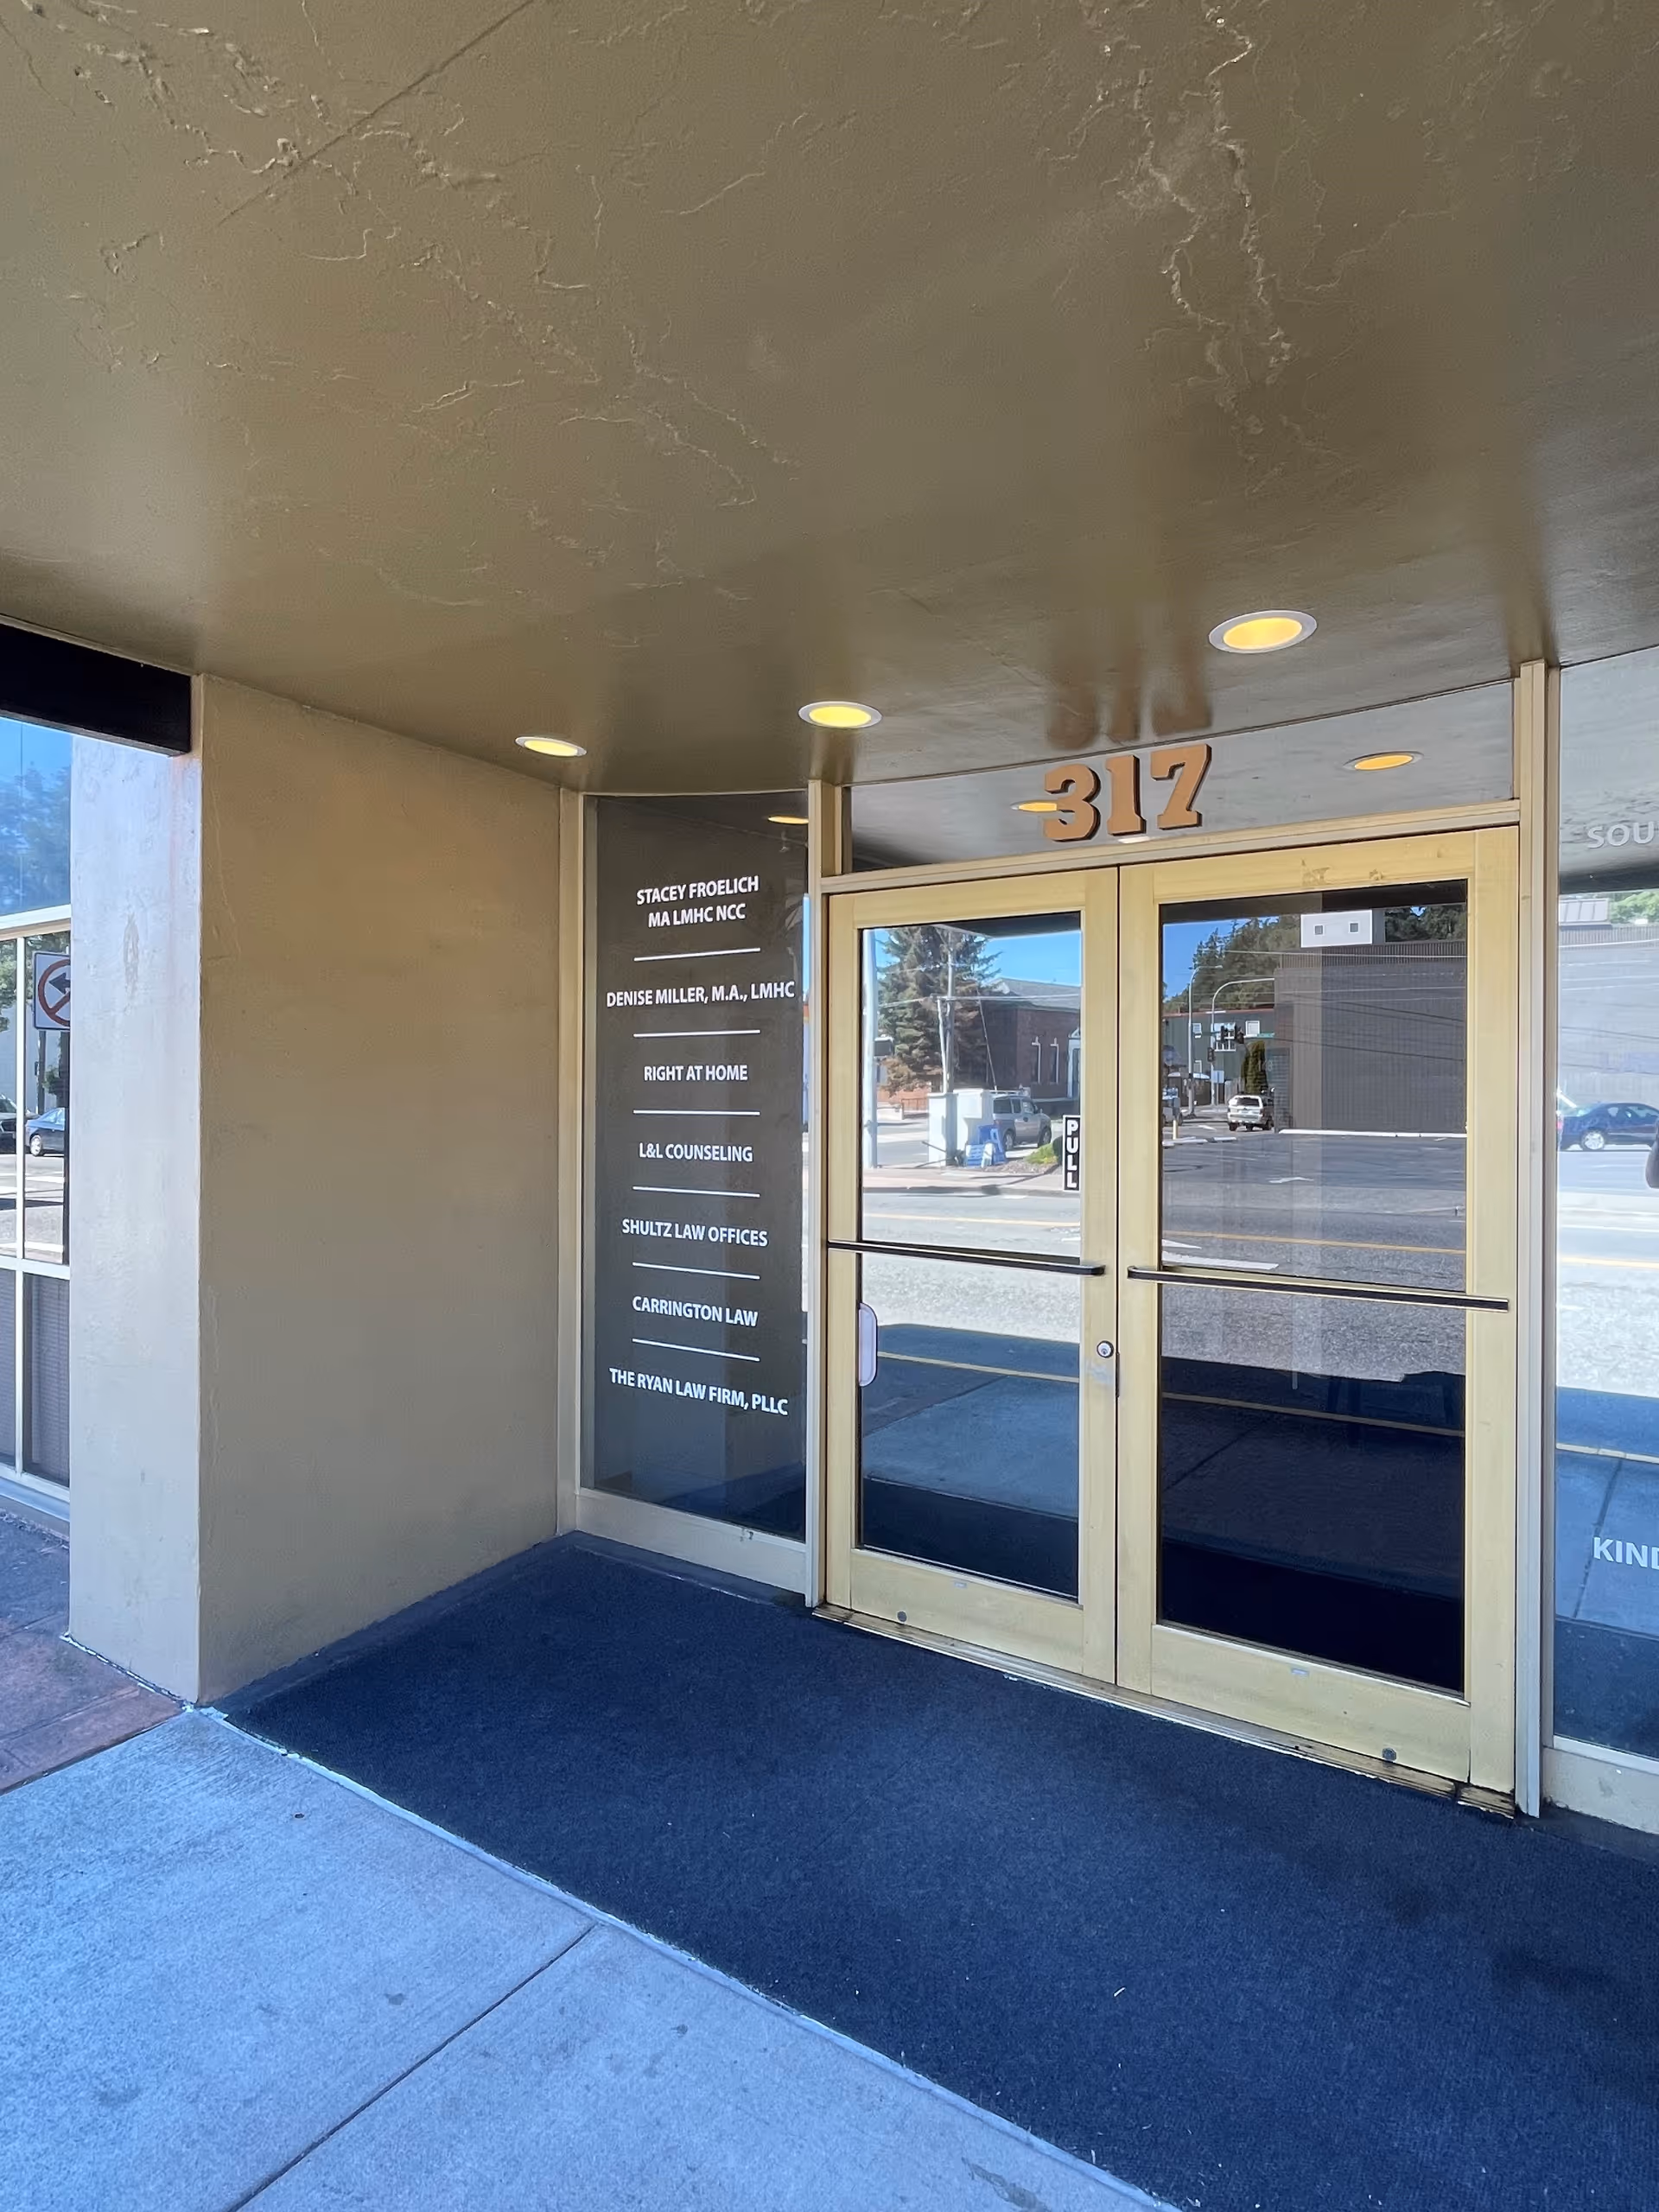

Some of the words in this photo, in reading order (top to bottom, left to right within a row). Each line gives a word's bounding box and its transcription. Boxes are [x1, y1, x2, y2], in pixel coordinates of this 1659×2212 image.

[1043, 743, 1212, 842] 317
[636, 884, 686, 905] STACEY
[689, 875, 758, 898] FROELICH
[648, 911, 670, 927] MA
[672, 906, 713, 925] LMHC
[715, 903, 745, 921] NCC
[607, 989, 652, 1007] DENISE
[655, 987, 709, 1004] MILLER,
[711, 984, 747, 1001] M.A.,
[751, 981, 794, 999] LMHC
[644, 1065, 683, 1080] RIGHT
[686, 1065, 702, 1080] AT
[705, 1065, 747, 1080] HOME
[639, 1142, 663, 1158] L&L
[664, 1143, 752, 1161] COUNSELING
[1066, 1120, 1079, 1188] PULL
[622, 1218, 671, 1237] SHULTZ
[675, 1223, 705, 1240] LAW
[708, 1226, 767, 1246] OFFICES
[632, 1295, 721, 1322] CARRINGTON
[725, 1307, 758, 1326] LAW
[609, 1367, 634, 1386] THE
[637, 1373, 672, 1393] RYAN
[676, 1380, 706, 1399] LAW
[709, 1386, 748, 1409] FIRM,
[752, 1393, 787, 1414] PLLC
